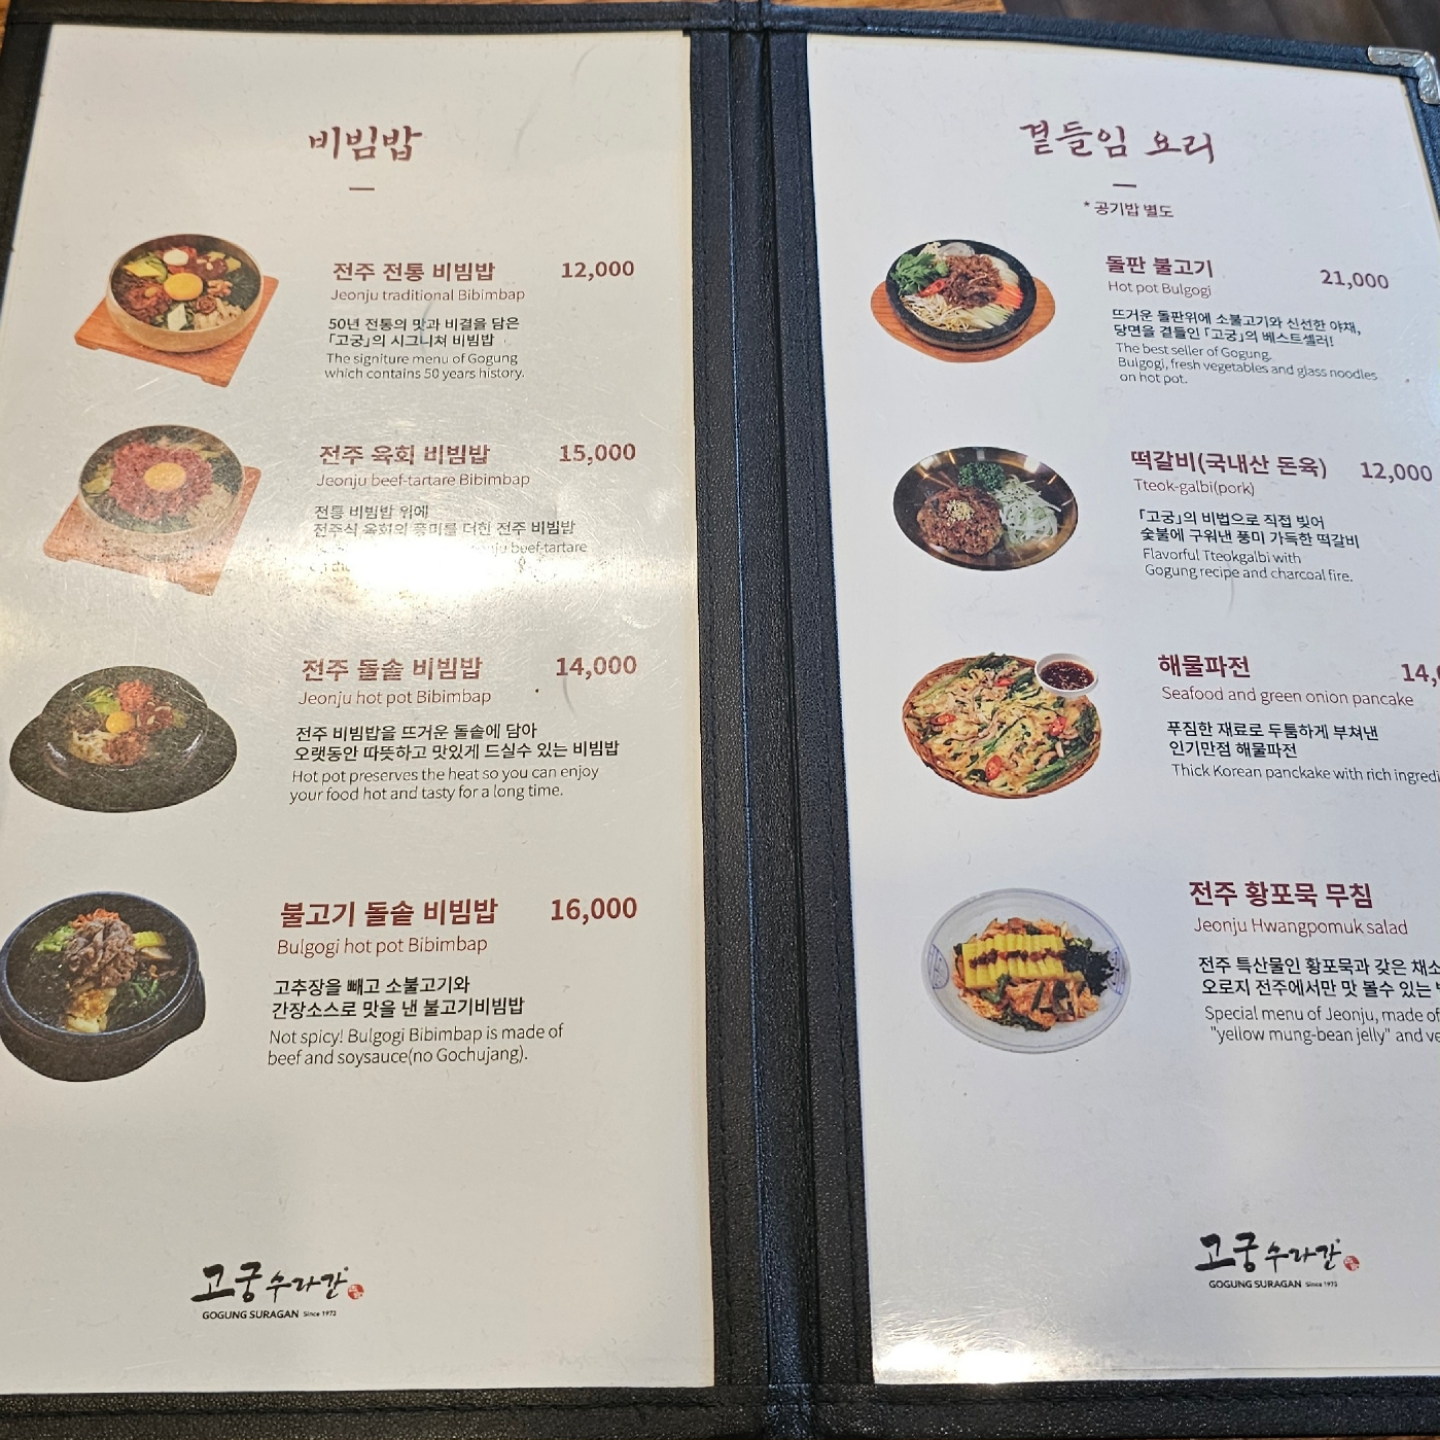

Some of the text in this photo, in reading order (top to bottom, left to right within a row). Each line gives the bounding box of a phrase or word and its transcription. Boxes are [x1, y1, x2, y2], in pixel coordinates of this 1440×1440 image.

[309, 125, 422, 161] 비빔밥
[1020, 120, 1215, 164] 곁들임 요리
[1094, 202, 1174, 218] 공기밥 별도
[333, 260, 635, 282] 전주 전통 비빔밥 12,000
[1106, 255, 1389, 290] 돌판 불고기 21,000
[331, 288, 525, 304] Jeonju traditional Bibimbap
[1108, 281, 1212, 299] Hot pot Bulgogi
[320, 443, 636, 465] 전주 육회 비빔밥 15,000
[1131, 450, 1432, 483] 떡갈비(국내산 돈육) 12,000
[317, 473, 529, 489] Jeonju beef-tartare Bibimbap
[1133, 478, 1255, 496] Tteok-galbi(pork)
[302, 655, 637, 682] 전주 돌솥 비빔밥 14,000
[1158, 654, 1250, 678] 해물파전
[299, 690, 491, 707] Jeonju hot pot Bibimbap
[1162, 686, 1414, 708] Seafood and green onion pancake
[296, 723, 537, 742] 전주 비빔밥을 뜨거운 돌솥에 담아
[1189, 880, 1373, 908] 전주 황포묵 무침
[281, 897, 638, 928] 불고기 돌솥 비빔밥 16,000
[1194, 917, 1408, 937] Jeonju Hwangpomuk salad
[278, 936, 488, 959] Bulgogi hot pot Bibimbap
[274, 976, 470, 997] 고추장을 빼고 소불고기와
[272, 997, 524, 1020] 간장소스로 맛을 낸 불고기비빔밥
[1209, 1281, 1252, 1289] GOGUNG
[1254, 1280, 1301, 1288] SURAGAN
[202, 1311, 247, 1319] GOGUNG
[250, 1310, 299, 1319] SURAGAN
